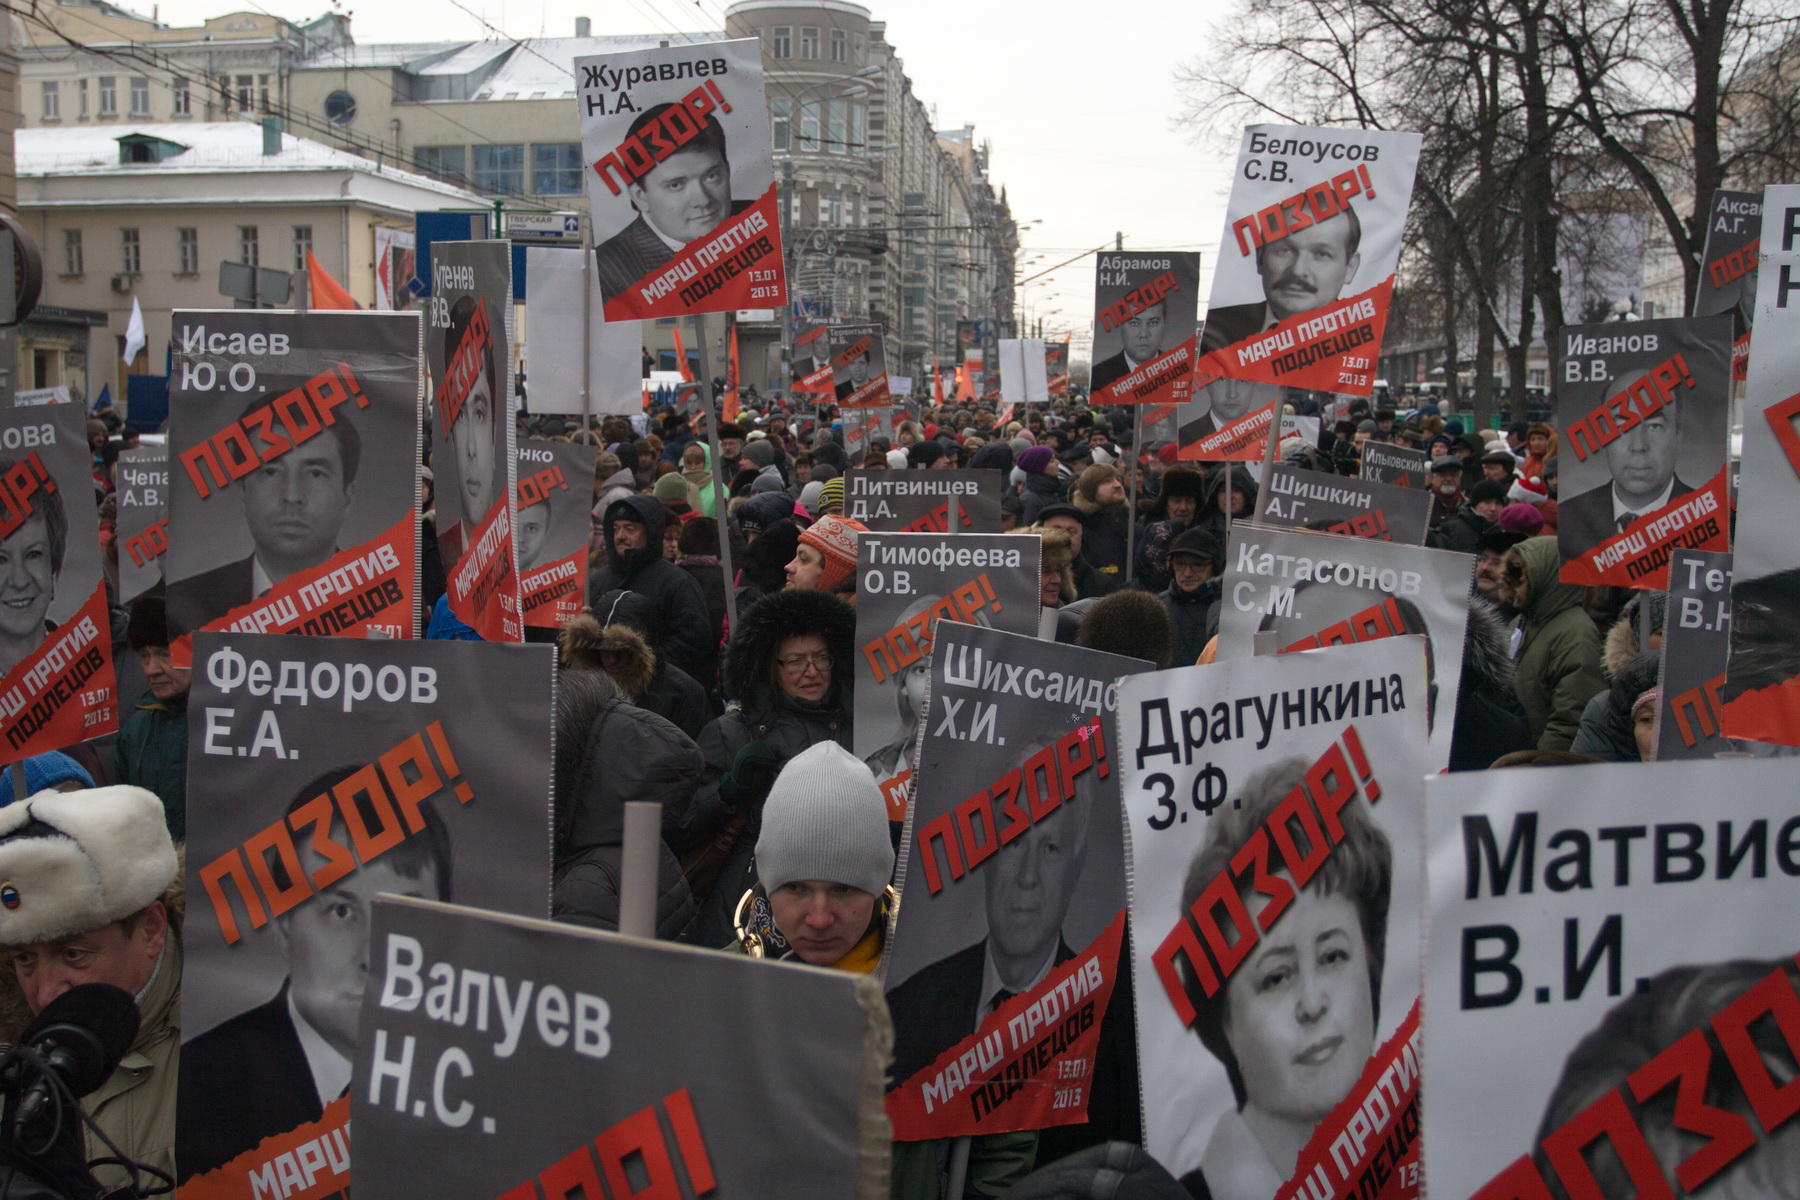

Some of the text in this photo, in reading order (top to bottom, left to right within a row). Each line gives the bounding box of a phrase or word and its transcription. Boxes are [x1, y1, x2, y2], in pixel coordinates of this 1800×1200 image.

[582, 57, 728, 92] Журавлев
[586, 94, 643, 117] Н.А.
[592, 78, 733, 197] ПОЗОР!
[1248, 132, 1379, 164] Белоусов
[1243, 159, 1294, 183] С.В.
[1231, 163, 1377, 257] ПОЗОР!
[1714, 210, 1748, 234] А.Г.
[1716, 196, 1763, 216] Акса
[639, 209, 770, 306] МАРШ ПРОТИВ
[678, 234, 775, 308] ПОДЛЕЦОВ
[748, 269, 778, 283] 13.01
[1100, 255, 1171, 272] Абрамов
[1100, 272, 1131, 286] Н.И.
[431, 296, 456, 329] В.В.
[750, 285, 780, 299] 2013
[1098, 270, 1181, 333] ПОЗОР!
[181, 325, 291, 356] Исаев
[1236, 297, 1378, 367] МАРШ ПРОТИВ
[1270, 323, 1376, 377] ПОДЛЕЦОВ
[1566, 333, 1659, 356] Иванов
[180, 361, 266, 393] Ю.О.
[437, 295, 494, 438] ПОЗОР!
[1111, 347, 1189, 397] МАРШ ПРОТИВ
[1133, 361, 1190, 400] ПОДЛЕЦОВ
[1337, 371, 1367, 387] 2013
[1340, 355, 1370, 370] 13.01
[1565, 359, 1615, 383] В.В.
[1564, 351, 1697, 463] ПОЗОР!
[0, 423, 57, 450] ова
[178, 360, 371, 500] ПОЗОР!
[1200, 430, 1233, 453] МАРШ
[1232, 408, 1274, 438] ПРОТИВ
[122, 489, 165, 507] А.В.
[516, 464, 570, 512] ОР!
[851, 476, 980, 499] Литвинцев
[1264, 496, 1309, 522] А.Г.
[1270, 472, 1372, 510] Шишкин
[850, 499, 898, 522] Д.А.
[1592, 489, 1719, 573] МАРШ ПРОТИВ
[455, 504, 510, 603] МАРШ ПРОТИВ
[865, 540, 1021, 573] Тимофеева
[1236, 542, 1423, 596] Катасонов
[298, 543, 401, 612] ПРОТИВ
[521, 559, 579, 594] ПРОТИВ
[863, 569, 917, 595] О.В.
[1232, 580, 1302, 620] С.М.
[862, 572, 1003, 684] ПОЗОР!
[22, 615, 100, 697] ПРОТИВ
[5, 645, 106, 751] ПОДЛЕЦОВ
[80, 687, 111, 708] 13.01
[206, 646, 439, 712] Федоров
[84, 707, 111, 728] 2013
[203, 706, 300, 761] Е.А.
[932, 695, 1007, 747] Х.И.
[1135, 672, 1406, 771] Драгункина
[916, 714, 1111, 897] ПОЗОР!
[1142, 762, 1242, 832] З.Ф.
[199, 719, 476, 945] ПОЗОР!
[1150, 724, 1383, 1031] ПОЗОР!
[1458, 913, 1651, 1012] В.И.
[379, 932, 612, 1059] Валуев
[920, 954, 1104, 1114] МАРШ ПРОТИВ
[367, 1029, 497, 1135] Н.С.
[968, 1000, 1097, 1124] ПОДЛЕЦОВ
[1057, 1057, 1087, 1081] 13.01
[1052, 1086, 1083, 1111] 2013
